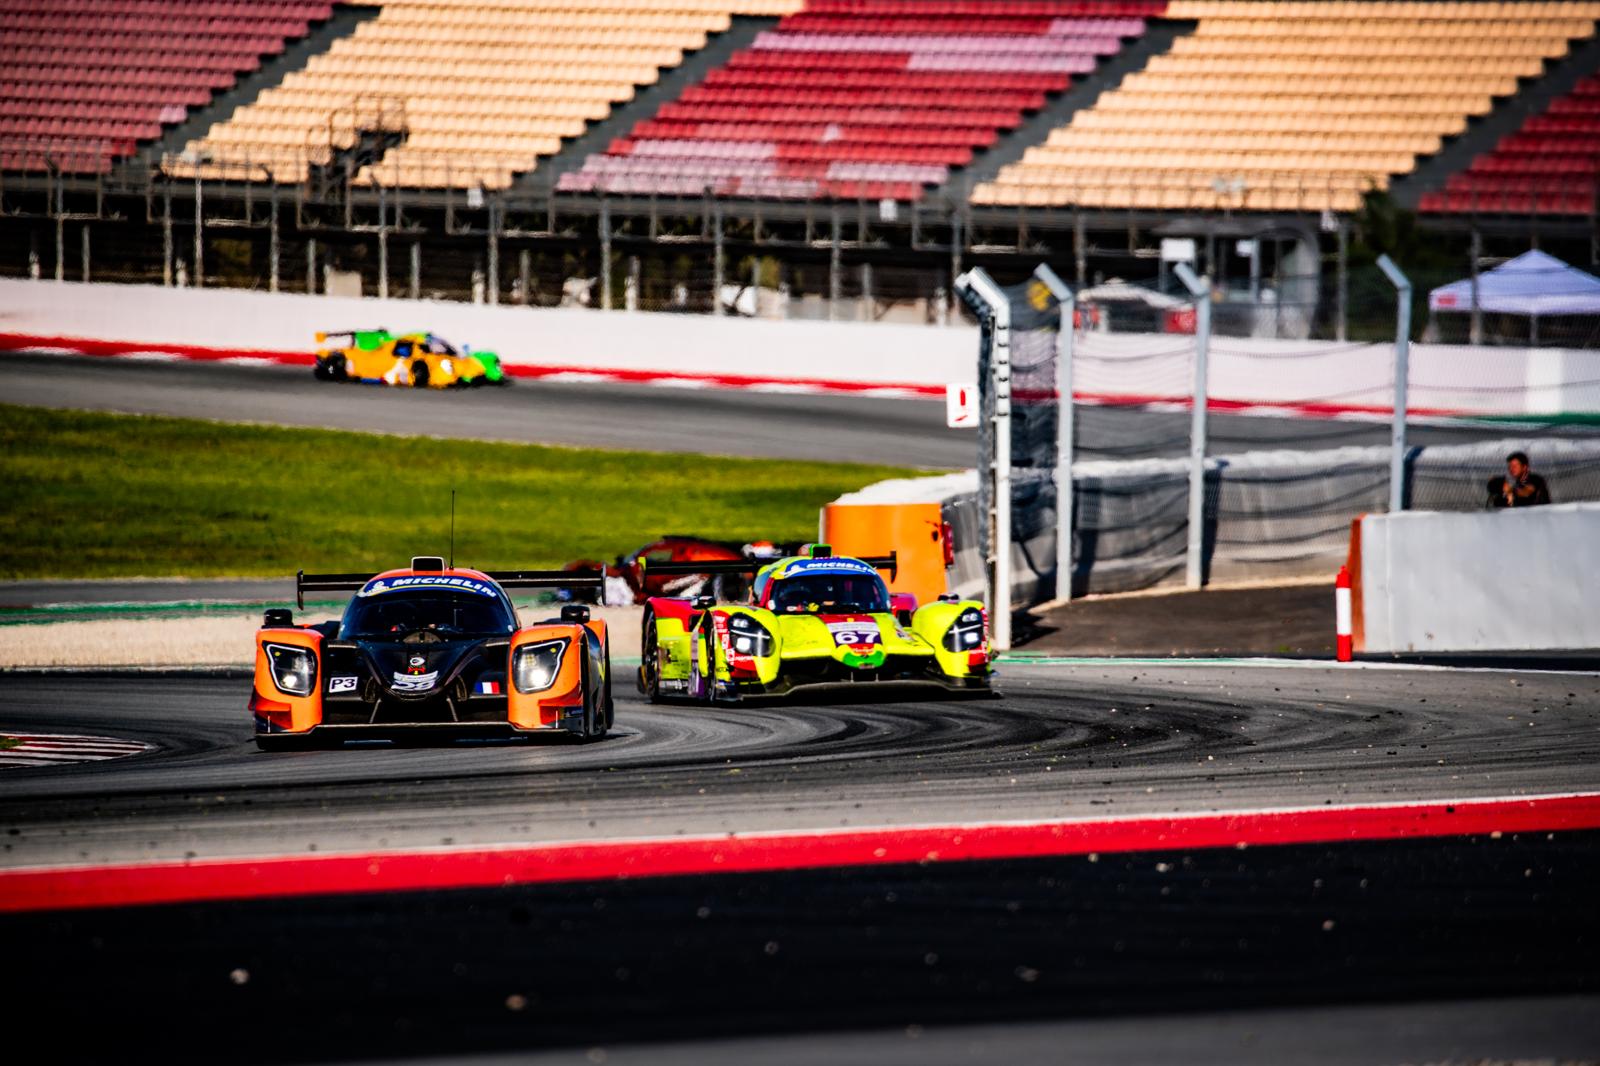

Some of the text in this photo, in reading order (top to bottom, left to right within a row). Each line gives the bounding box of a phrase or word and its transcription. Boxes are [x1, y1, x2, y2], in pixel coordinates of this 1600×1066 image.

[392, 577, 497, 597] MICHELIN
[835, 630, 879, 645] 67
[331, 678, 356, 690] P3
